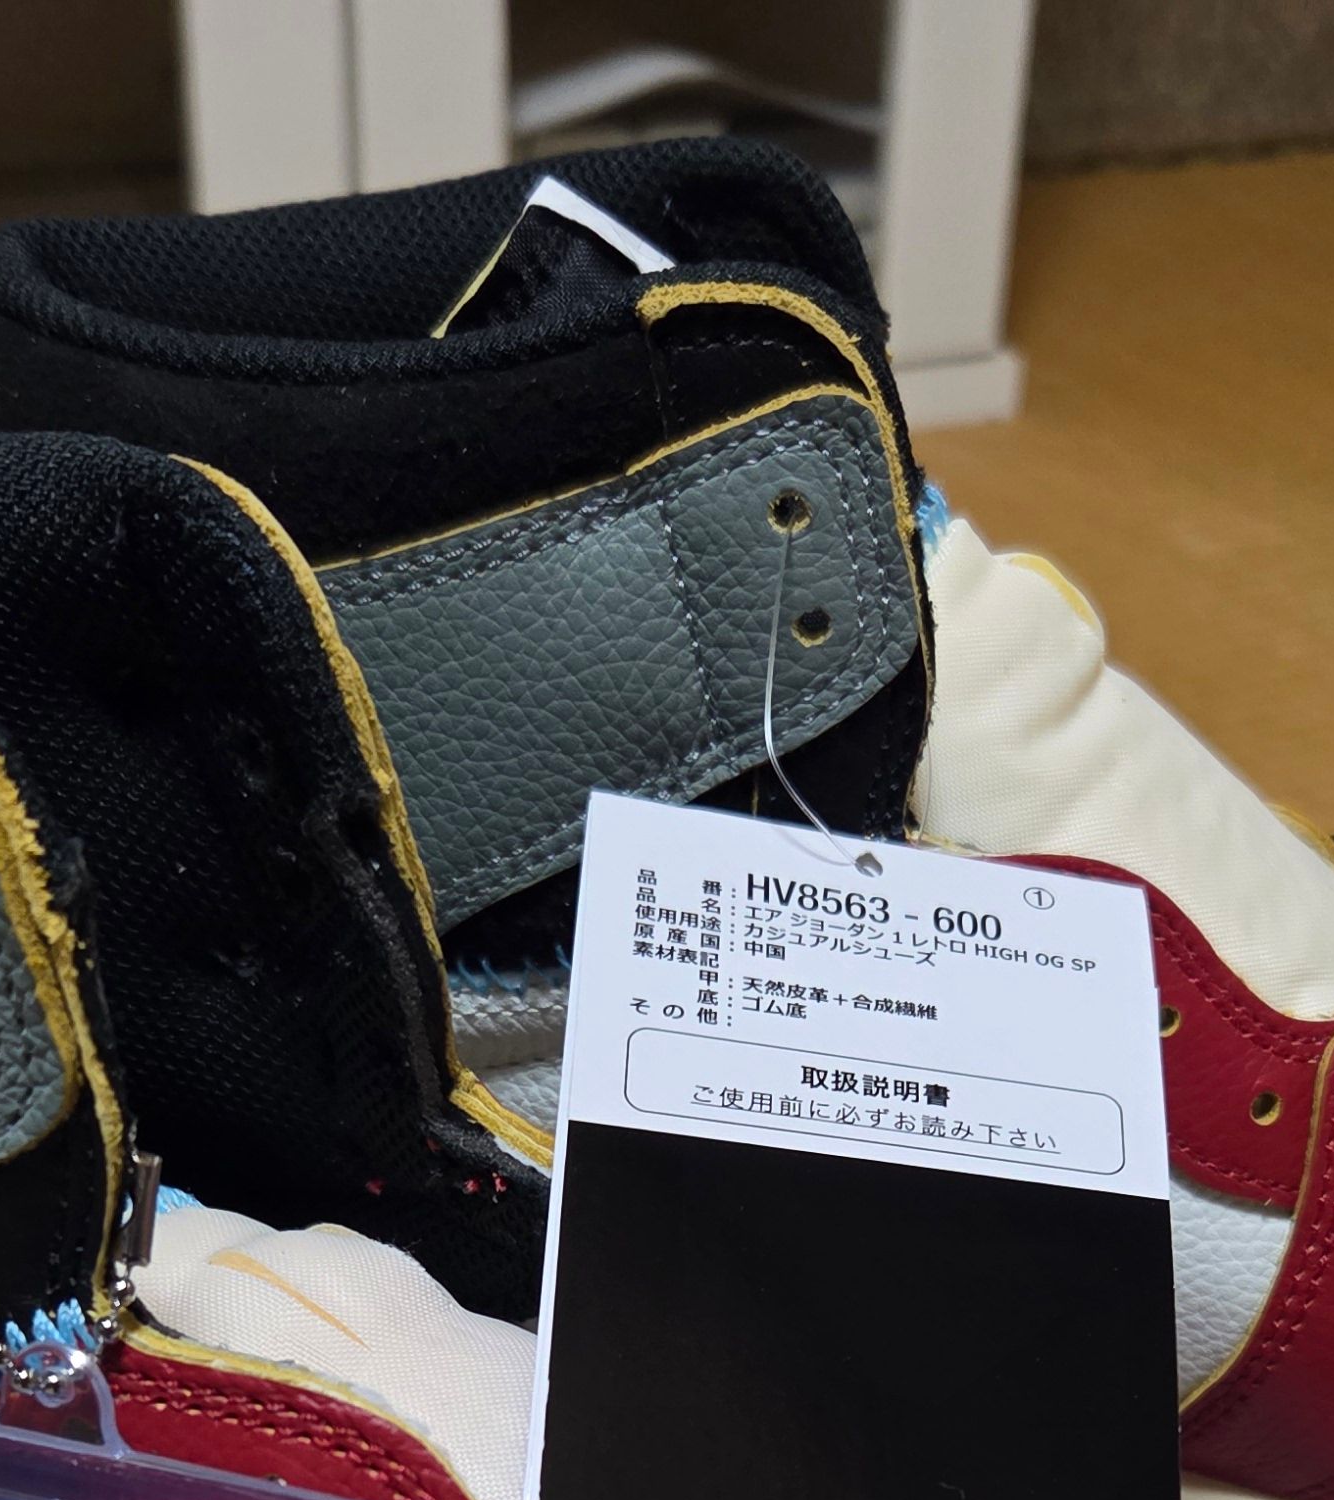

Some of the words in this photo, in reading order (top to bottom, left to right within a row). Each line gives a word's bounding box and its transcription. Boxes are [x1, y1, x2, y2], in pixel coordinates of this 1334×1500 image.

[746, 873, 891, 924] HV8563
[933, 906, 1003, 942] 600
[632, 940, 720, 969] 素材表記
[743, 922, 937, 968] カジュアルシューズ
[744, 905, 783, 923] エア
[791, 913, 885, 941] ジョーダン
[893, 931, 903, 945] 1
[912, 933, 967, 955] レトロ
[975, 943, 1028, 964] HIGH
[1035, 952, 1065, 969] OG
[1071, 957, 1097, 973] SP
[744, 941, 786, 961] 中国
[741, 995, 808, 1019] ゴム底
[800, 1065, 950, 1108] 取扱説明書
[691, 1084, 1058, 1150] ご使用前に必ずお読み下さい
